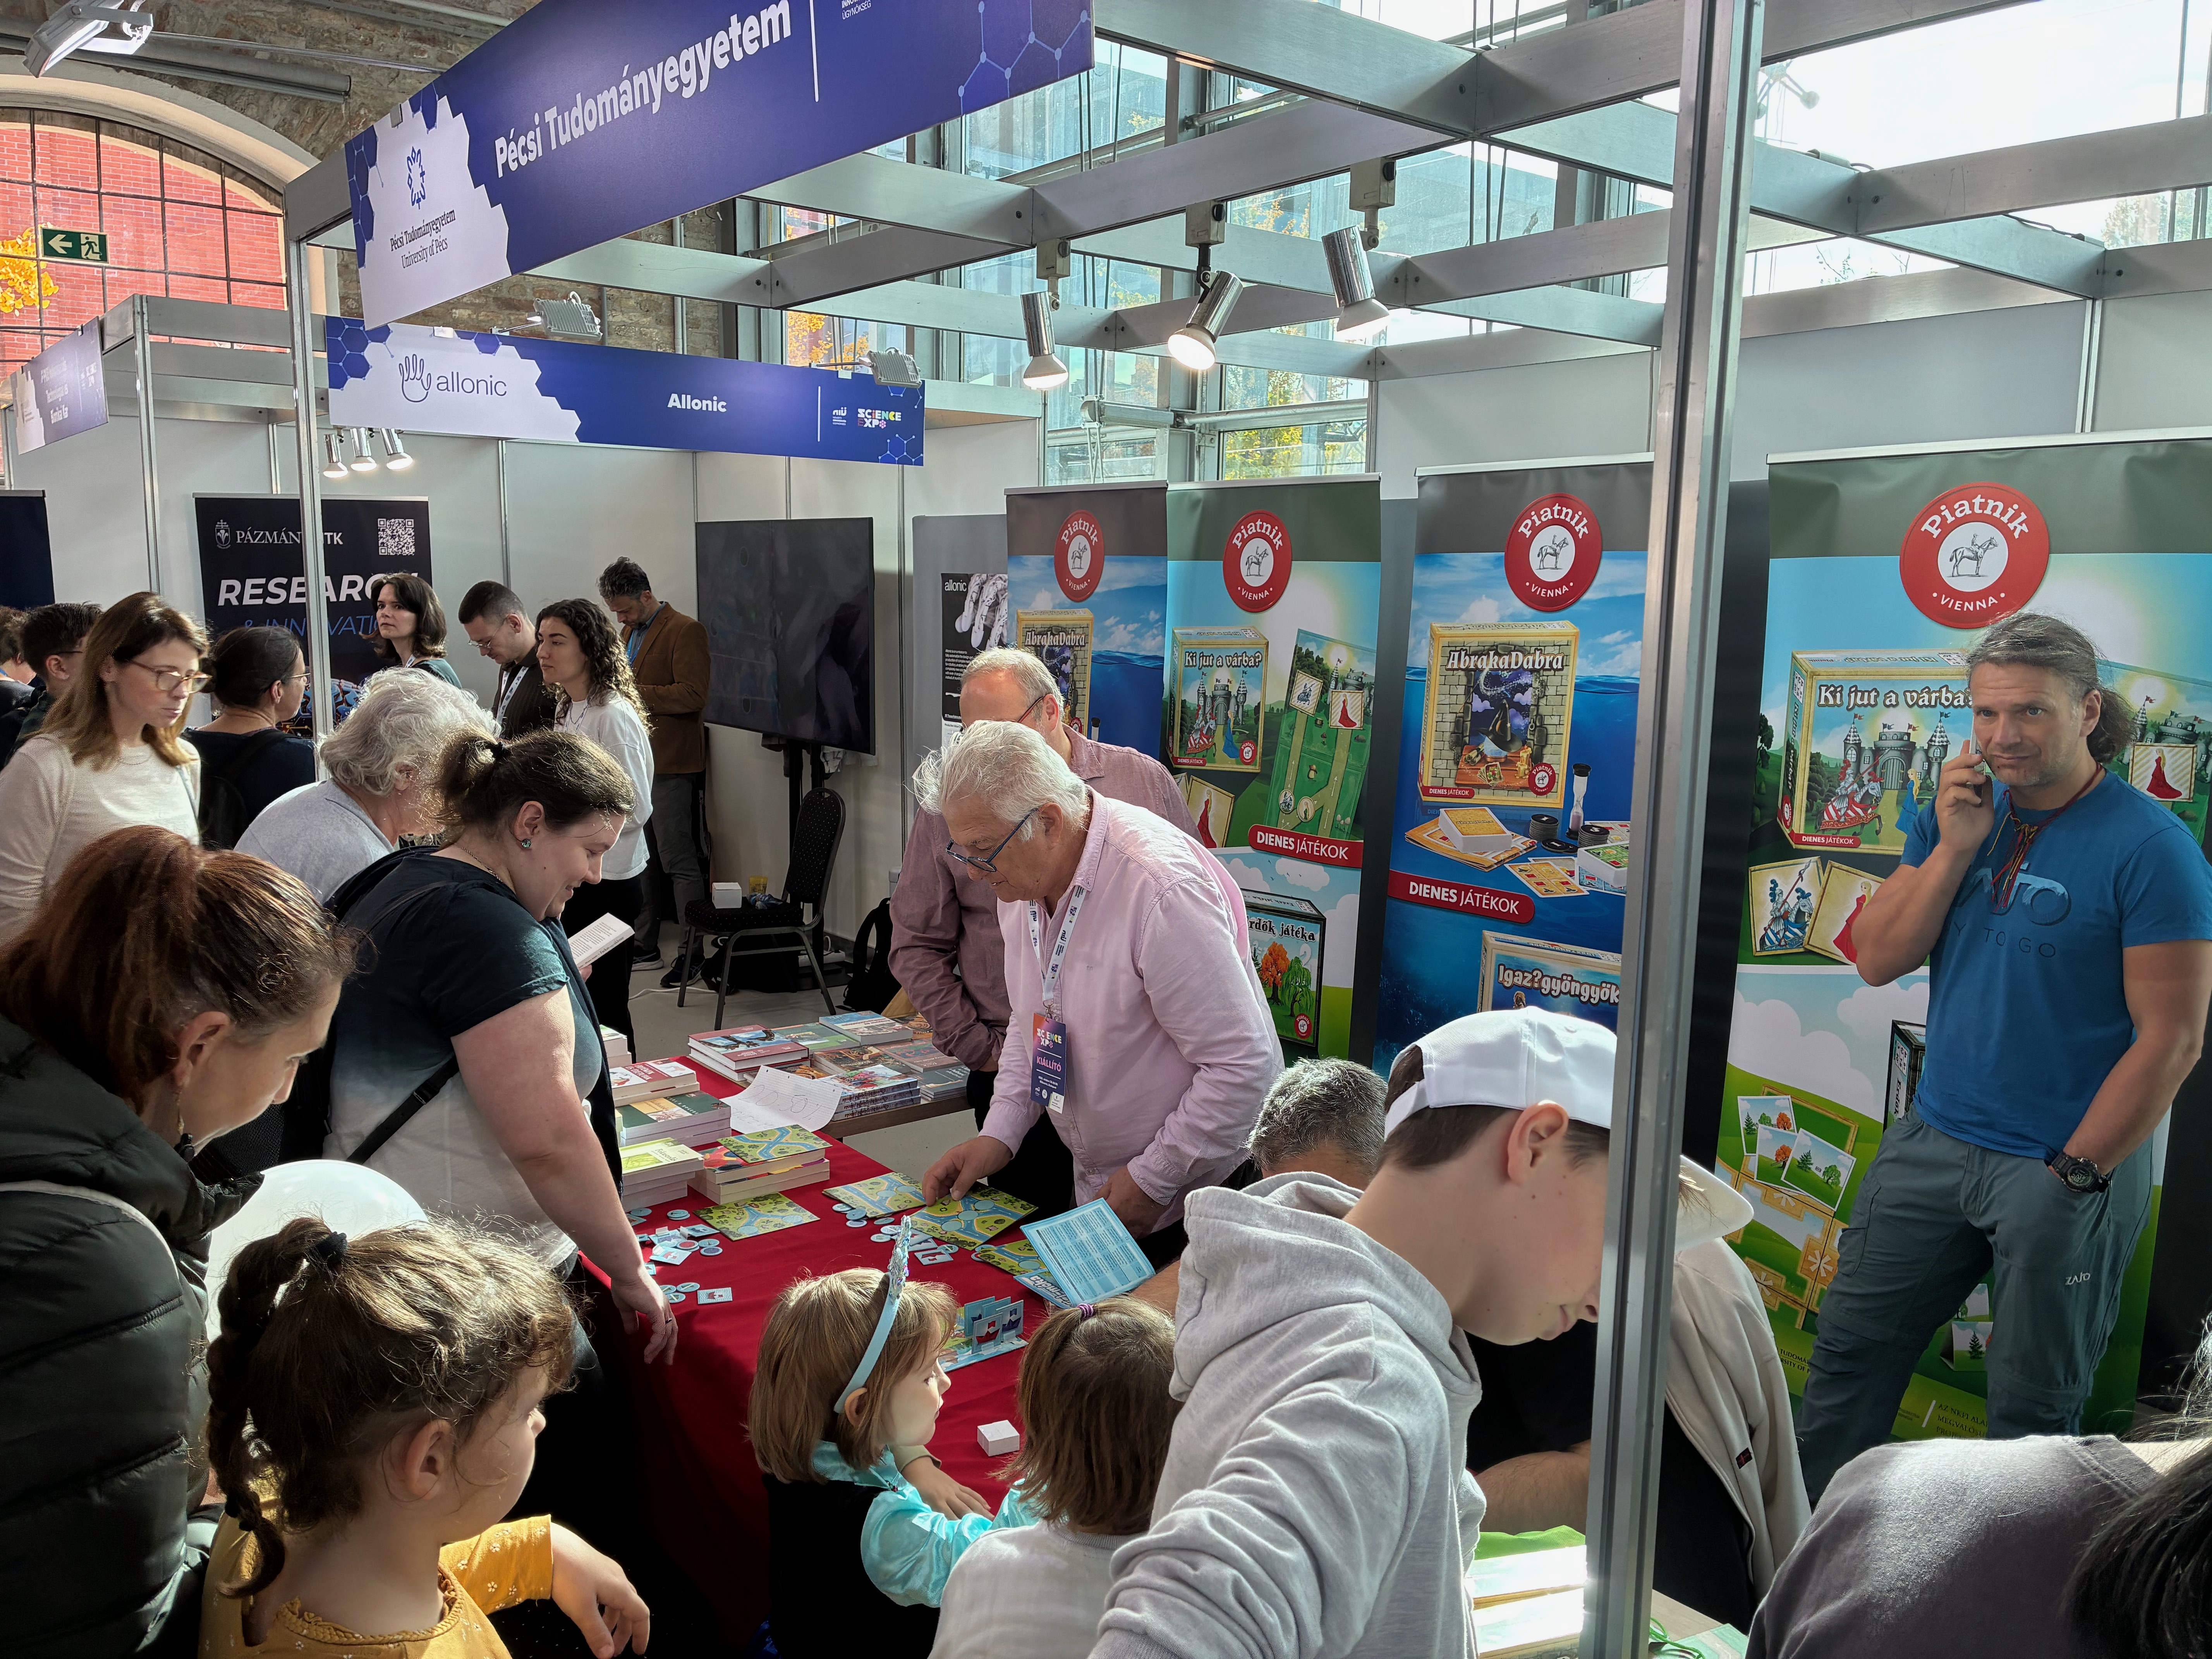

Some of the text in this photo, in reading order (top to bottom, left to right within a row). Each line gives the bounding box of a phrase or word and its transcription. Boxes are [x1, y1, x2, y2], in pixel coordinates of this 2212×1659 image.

[495, 0, 791, 178] Pécsi Tudományegyetem
[390, 210, 456, 251] Pécsi Tudományegyetem
[401, 235, 448, 269] University of Pécs
[436, 371, 507, 397] allonic
[667, 393, 727, 412] Allonic
[1518, 503, 1589, 539] Piatnik
[1920, 494, 2029, 540] Piatnik
[236, 527, 343, 545] PÁZMÁN TK
[1061, 518, 1098, 546] Piatnik
[1232, 519, 1283, 550] Piatnik
[218, 572, 418, 606] RESEARC
[944, 579, 967, 592] allonic
[1068, 580, 1088, 590] VIENNA
[1242, 588, 1269, 600] VIENNA
[1530, 582, 1570, 598] VIENNA
[1940, 594, 1998, 612] VIENNA
[1025, 631, 1085, 646] AbrakaDabra
[1185, 652, 1262, 669] Ki jut a várba?
[1447, 649, 1565, 671] AbrakaDabra
[1819, 686, 1843, 705] Ki
[1848, 685, 1878, 709] jut
[1885, 691, 1897, 706] a
[1532, 764, 1553, 776] Piatnik
[1257, 831, 1348, 860] DIENES JÁTÉKOK
[1826, 836, 1853, 845] JÁTÉKOK
[1409, 881, 1519, 914] DIENES JÁTÉKOK
[1247, 915, 1316, 942] rdők játéka
[2019, 937, 2056, 958] GO
[1498, 965, 1620, 1004] Igaz?gyöngyök
[1037, 1056, 1061, 1072] KIÁLLÍTÓ
